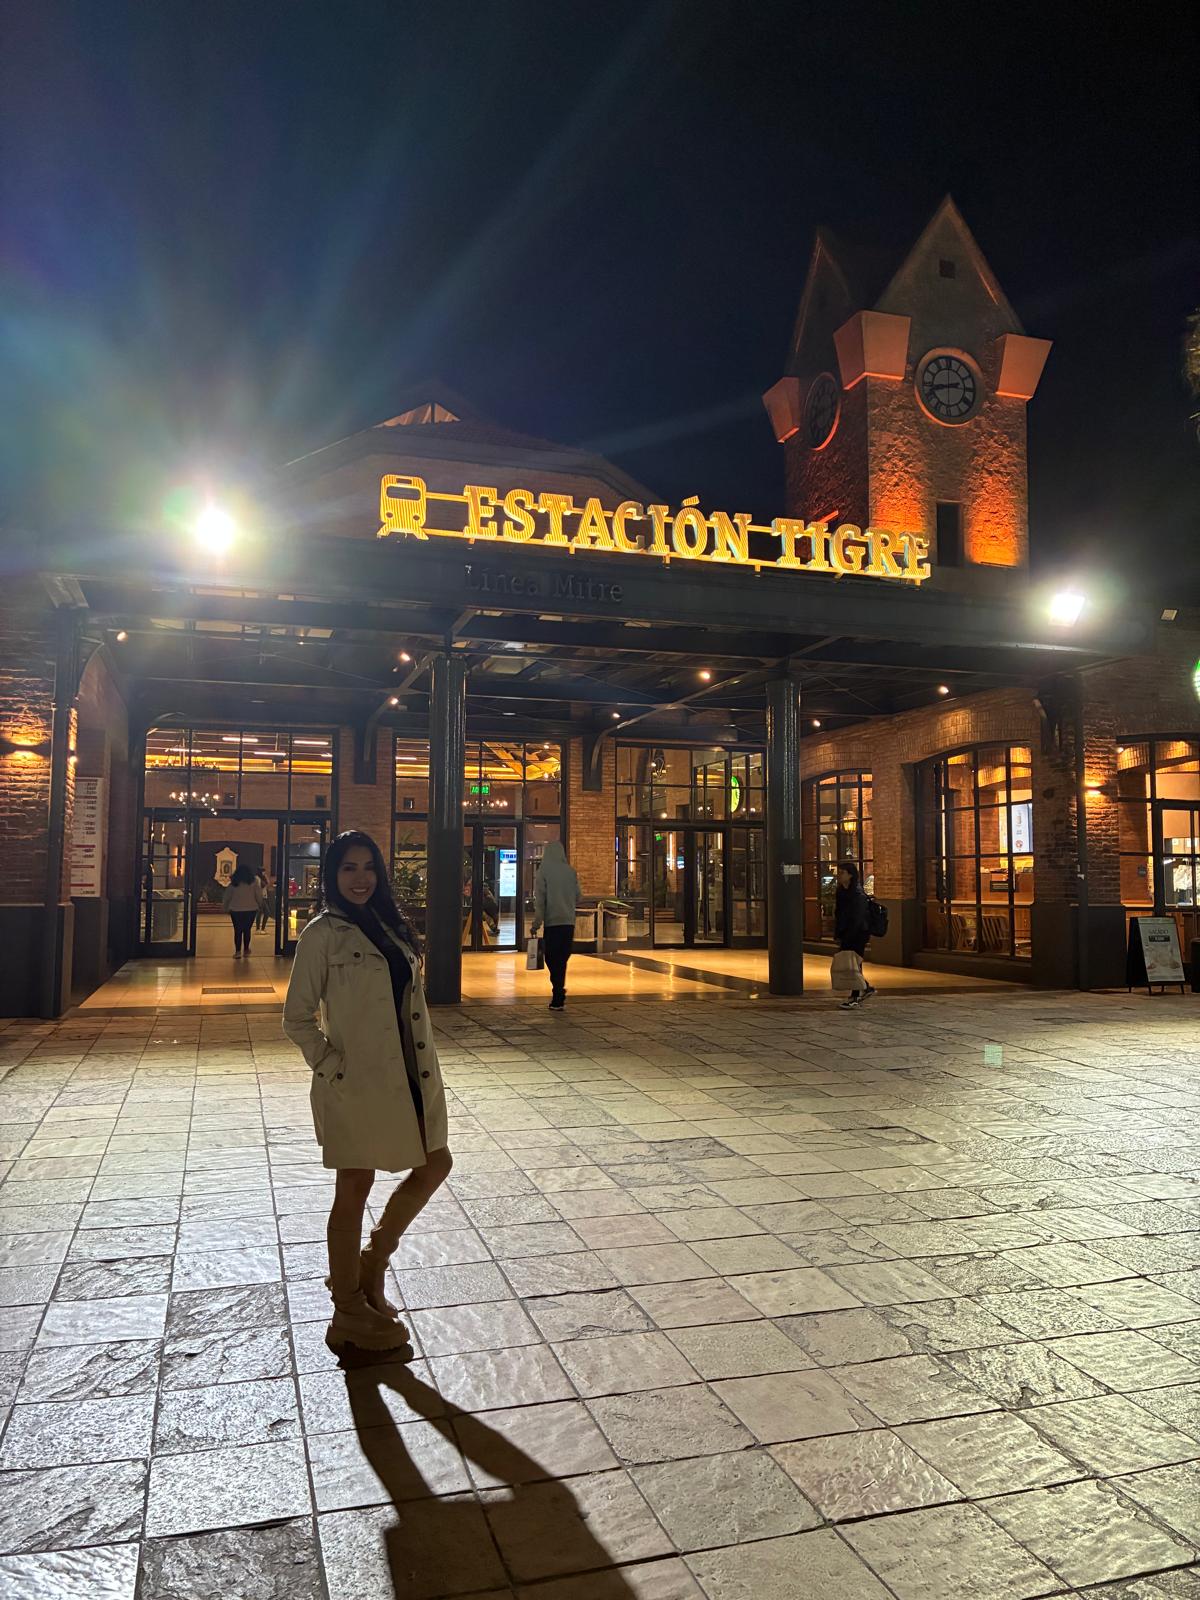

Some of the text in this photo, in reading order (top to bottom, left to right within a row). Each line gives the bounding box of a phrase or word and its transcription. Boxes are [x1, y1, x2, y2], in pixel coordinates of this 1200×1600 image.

[464, 484, 932, 579] ESTACIÓN TIGRE
[553, 574, 624, 602] Mitre
